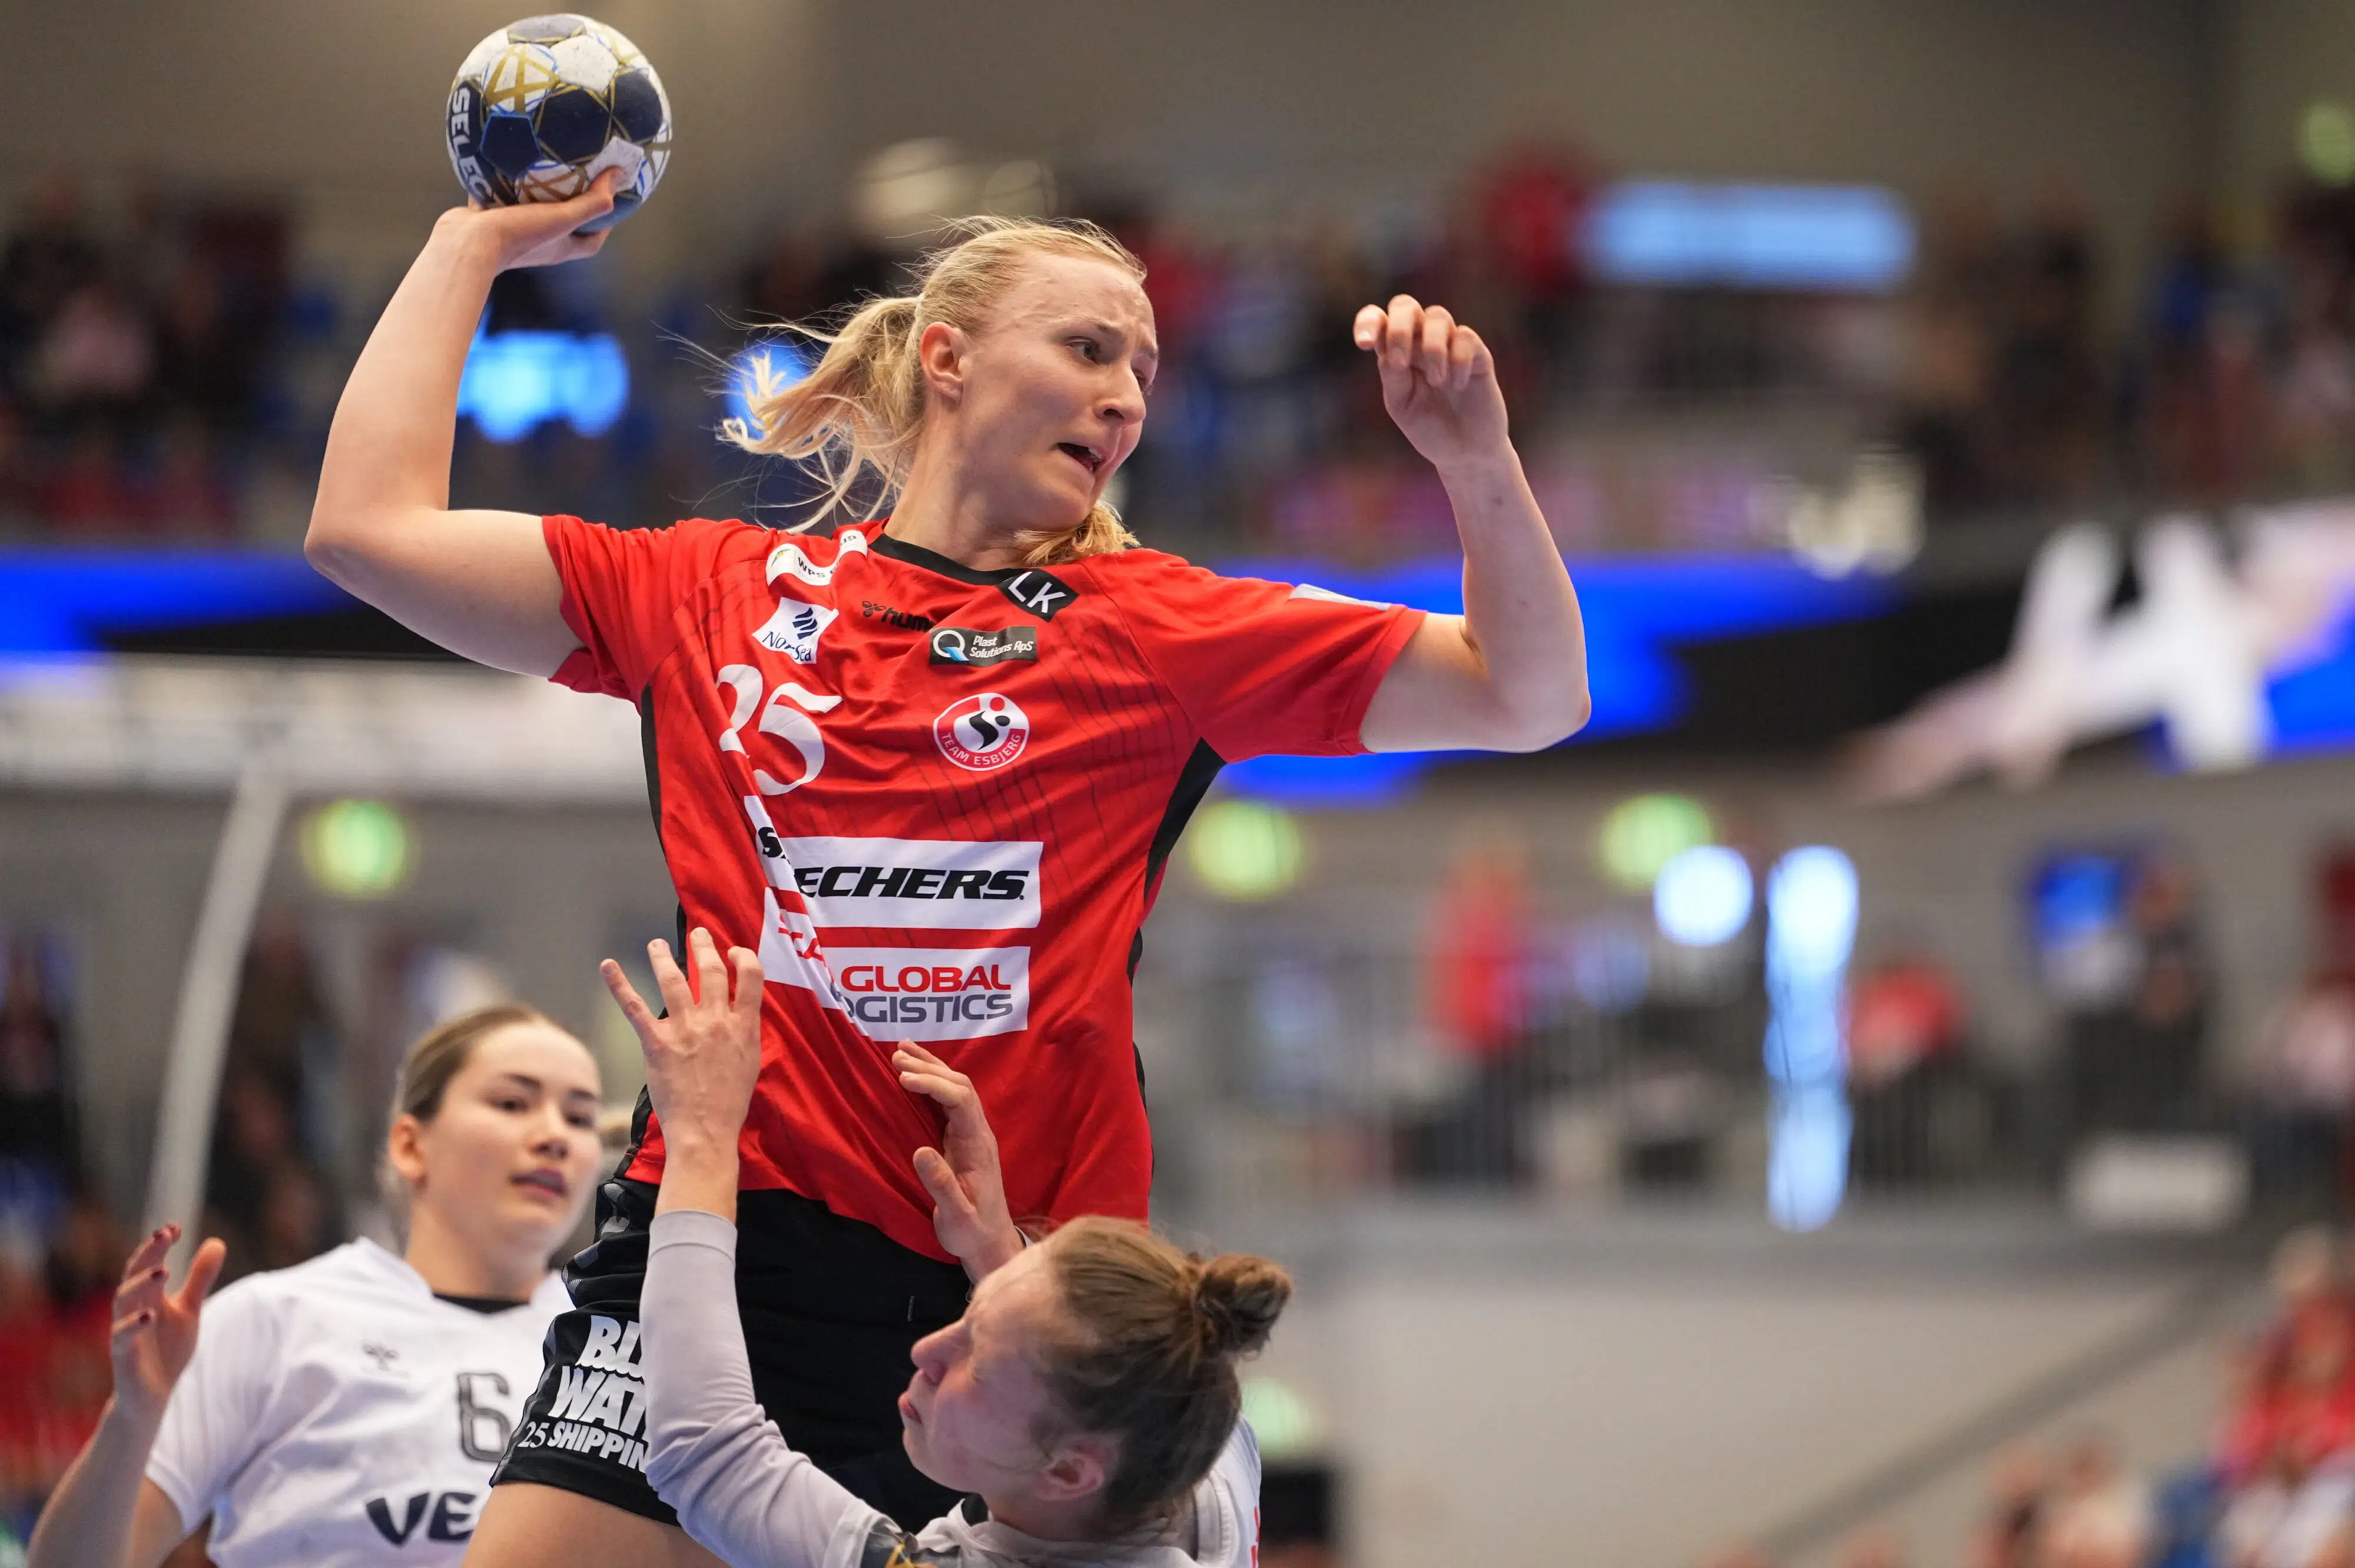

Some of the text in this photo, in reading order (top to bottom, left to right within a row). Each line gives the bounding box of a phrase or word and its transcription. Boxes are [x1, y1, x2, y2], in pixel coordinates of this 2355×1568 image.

[881, 607, 937, 633] hum
[762, 630, 812, 662] NorSea
[969, 640, 1034, 658] Solutions ApS
[973, 635, 999, 647] Plast
[715, 663, 844, 796] 25
[942, 732, 1021, 765] TEAM ESBJERG
[757, 826, 1030, 901] SECHERS
[840, 964, 1012, 993] GLOBAL
[831, 984, 1013, 1024] GISTICS
[575, 1314, 644, 1378] BL
[455, 1371, 512, 1464] 6
[548, 1366, 646, 1441] WAT
[517, 1421, 550, 1449] 25
